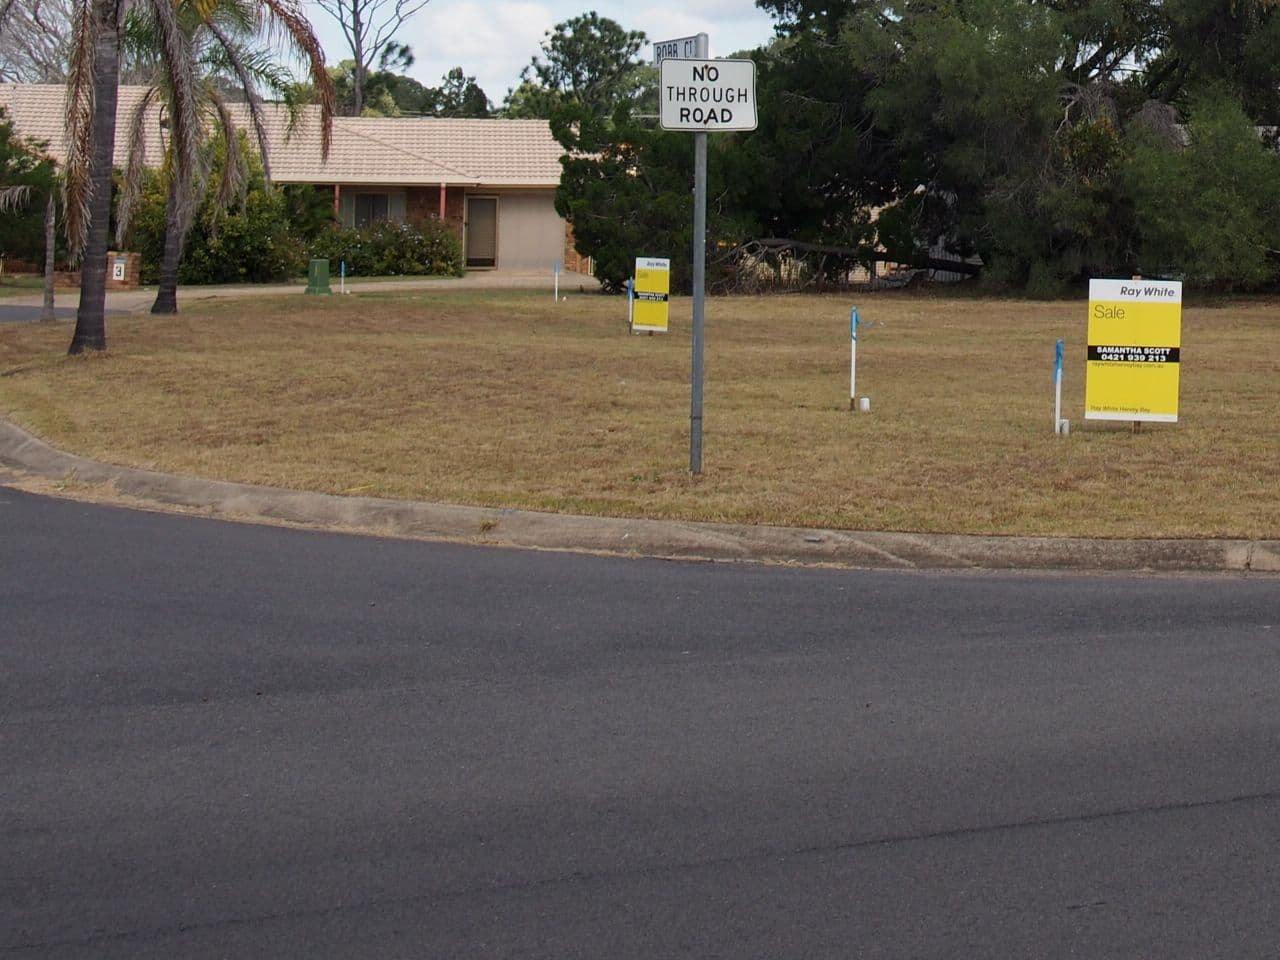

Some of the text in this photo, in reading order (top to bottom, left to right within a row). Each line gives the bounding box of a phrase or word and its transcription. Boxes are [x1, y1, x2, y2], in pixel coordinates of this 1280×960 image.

[693, 66, 719, 81] NO
[667, 86, 748, 103] THROUGH
[680, 107, 733, 123] ROAD
[115, 266, 122, 277] 3
[1120, 286, 1175, 297] Ray White
[1096, 346, 1171, 355] SAMANTHA SCOTT
